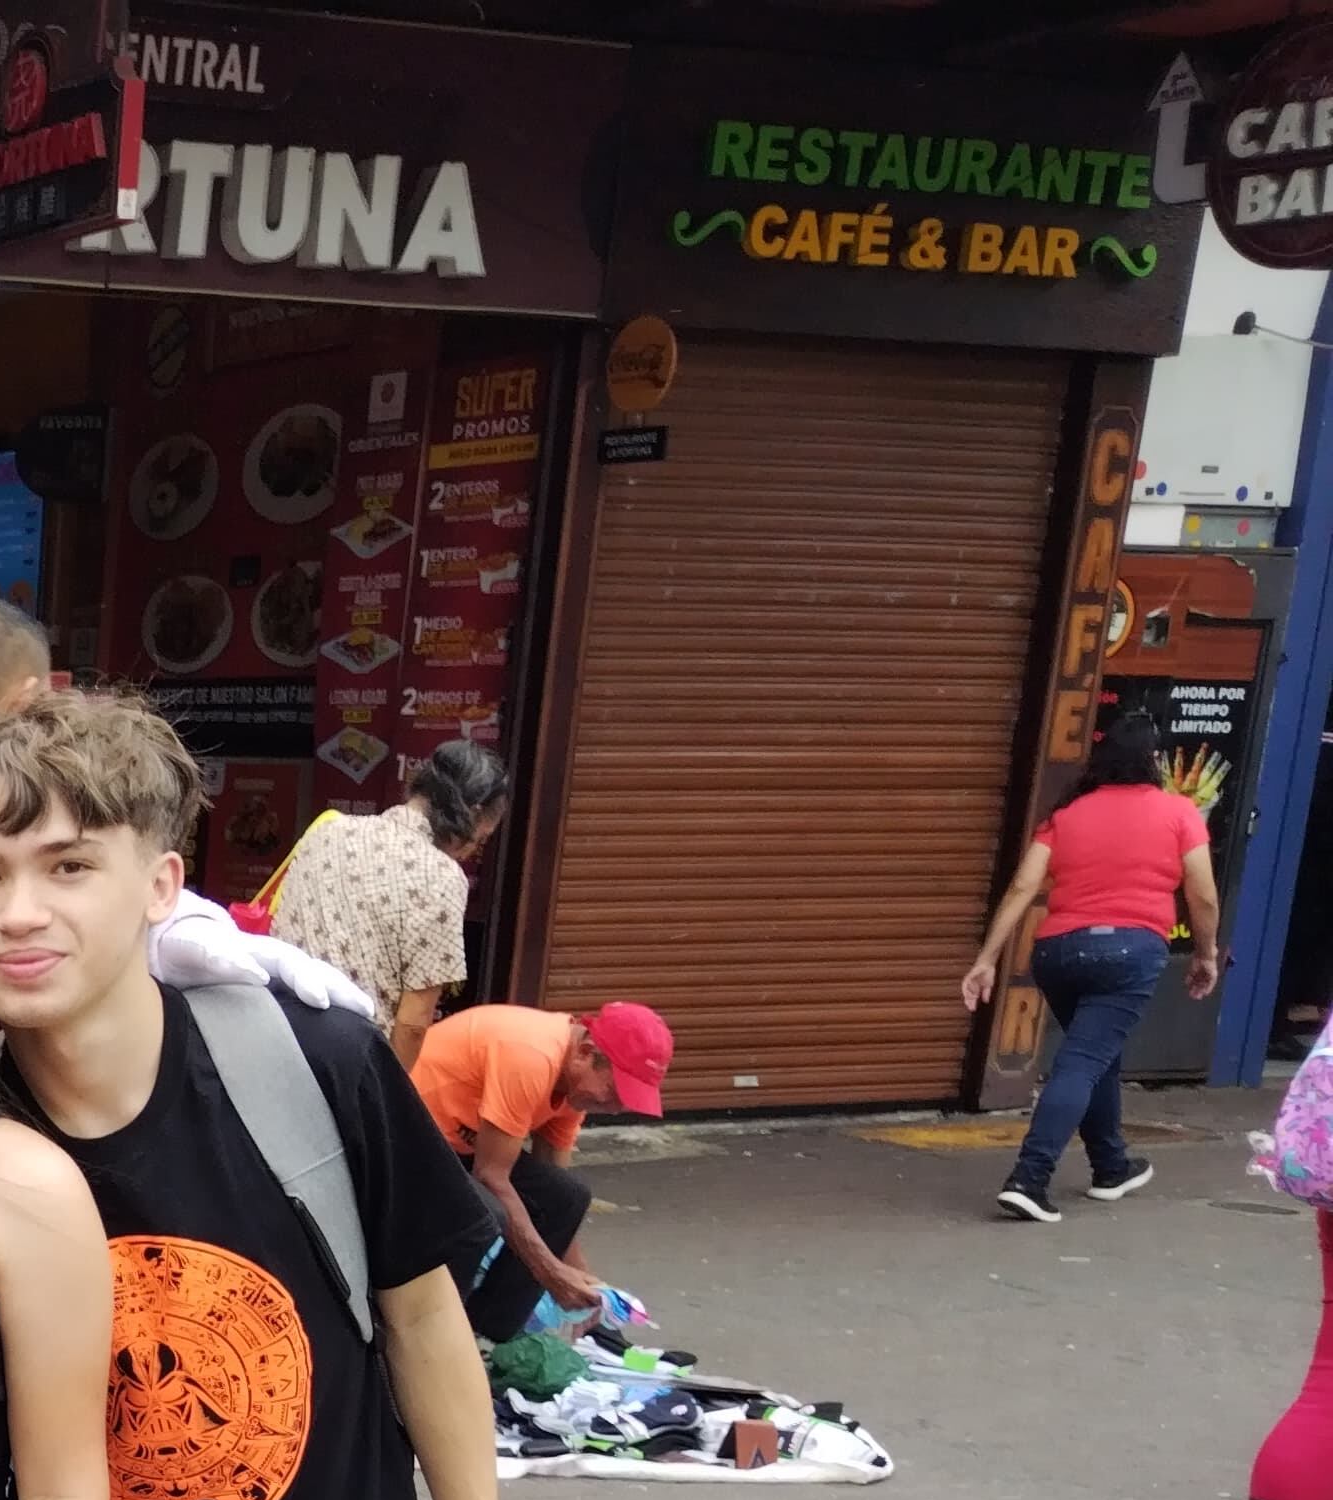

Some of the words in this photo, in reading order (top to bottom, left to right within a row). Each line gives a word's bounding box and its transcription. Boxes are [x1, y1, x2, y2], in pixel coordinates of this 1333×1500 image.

[709, 118, 1153, 210] RESTAURANTE
[1235, 163, 1333, 225] BA
[743, 201, 895, 268] CAFÉ
[901, 216, 948, 271] &
[961, 220, 1080, 279] BAR
[452, 414, 531, 441] PROMOS
[428, 481, 445, 511] 2
[419, 549, 429, 578] 1
[428, 546, 478, 562] ENTERO
[414, 616, 422, 645] 1
[422, 616, 464, 631] MEDIO
[399, 686, 416, 716] 2
[416, 689, 463, 705] MEDIOS
[1170, 685, 1216, 701] AHORA
[1219, 687, 1246, 701] POR
[1180, 702, 1230, 718] TIEMPO
[1171, 719, 1233, 734] LIMITADO
